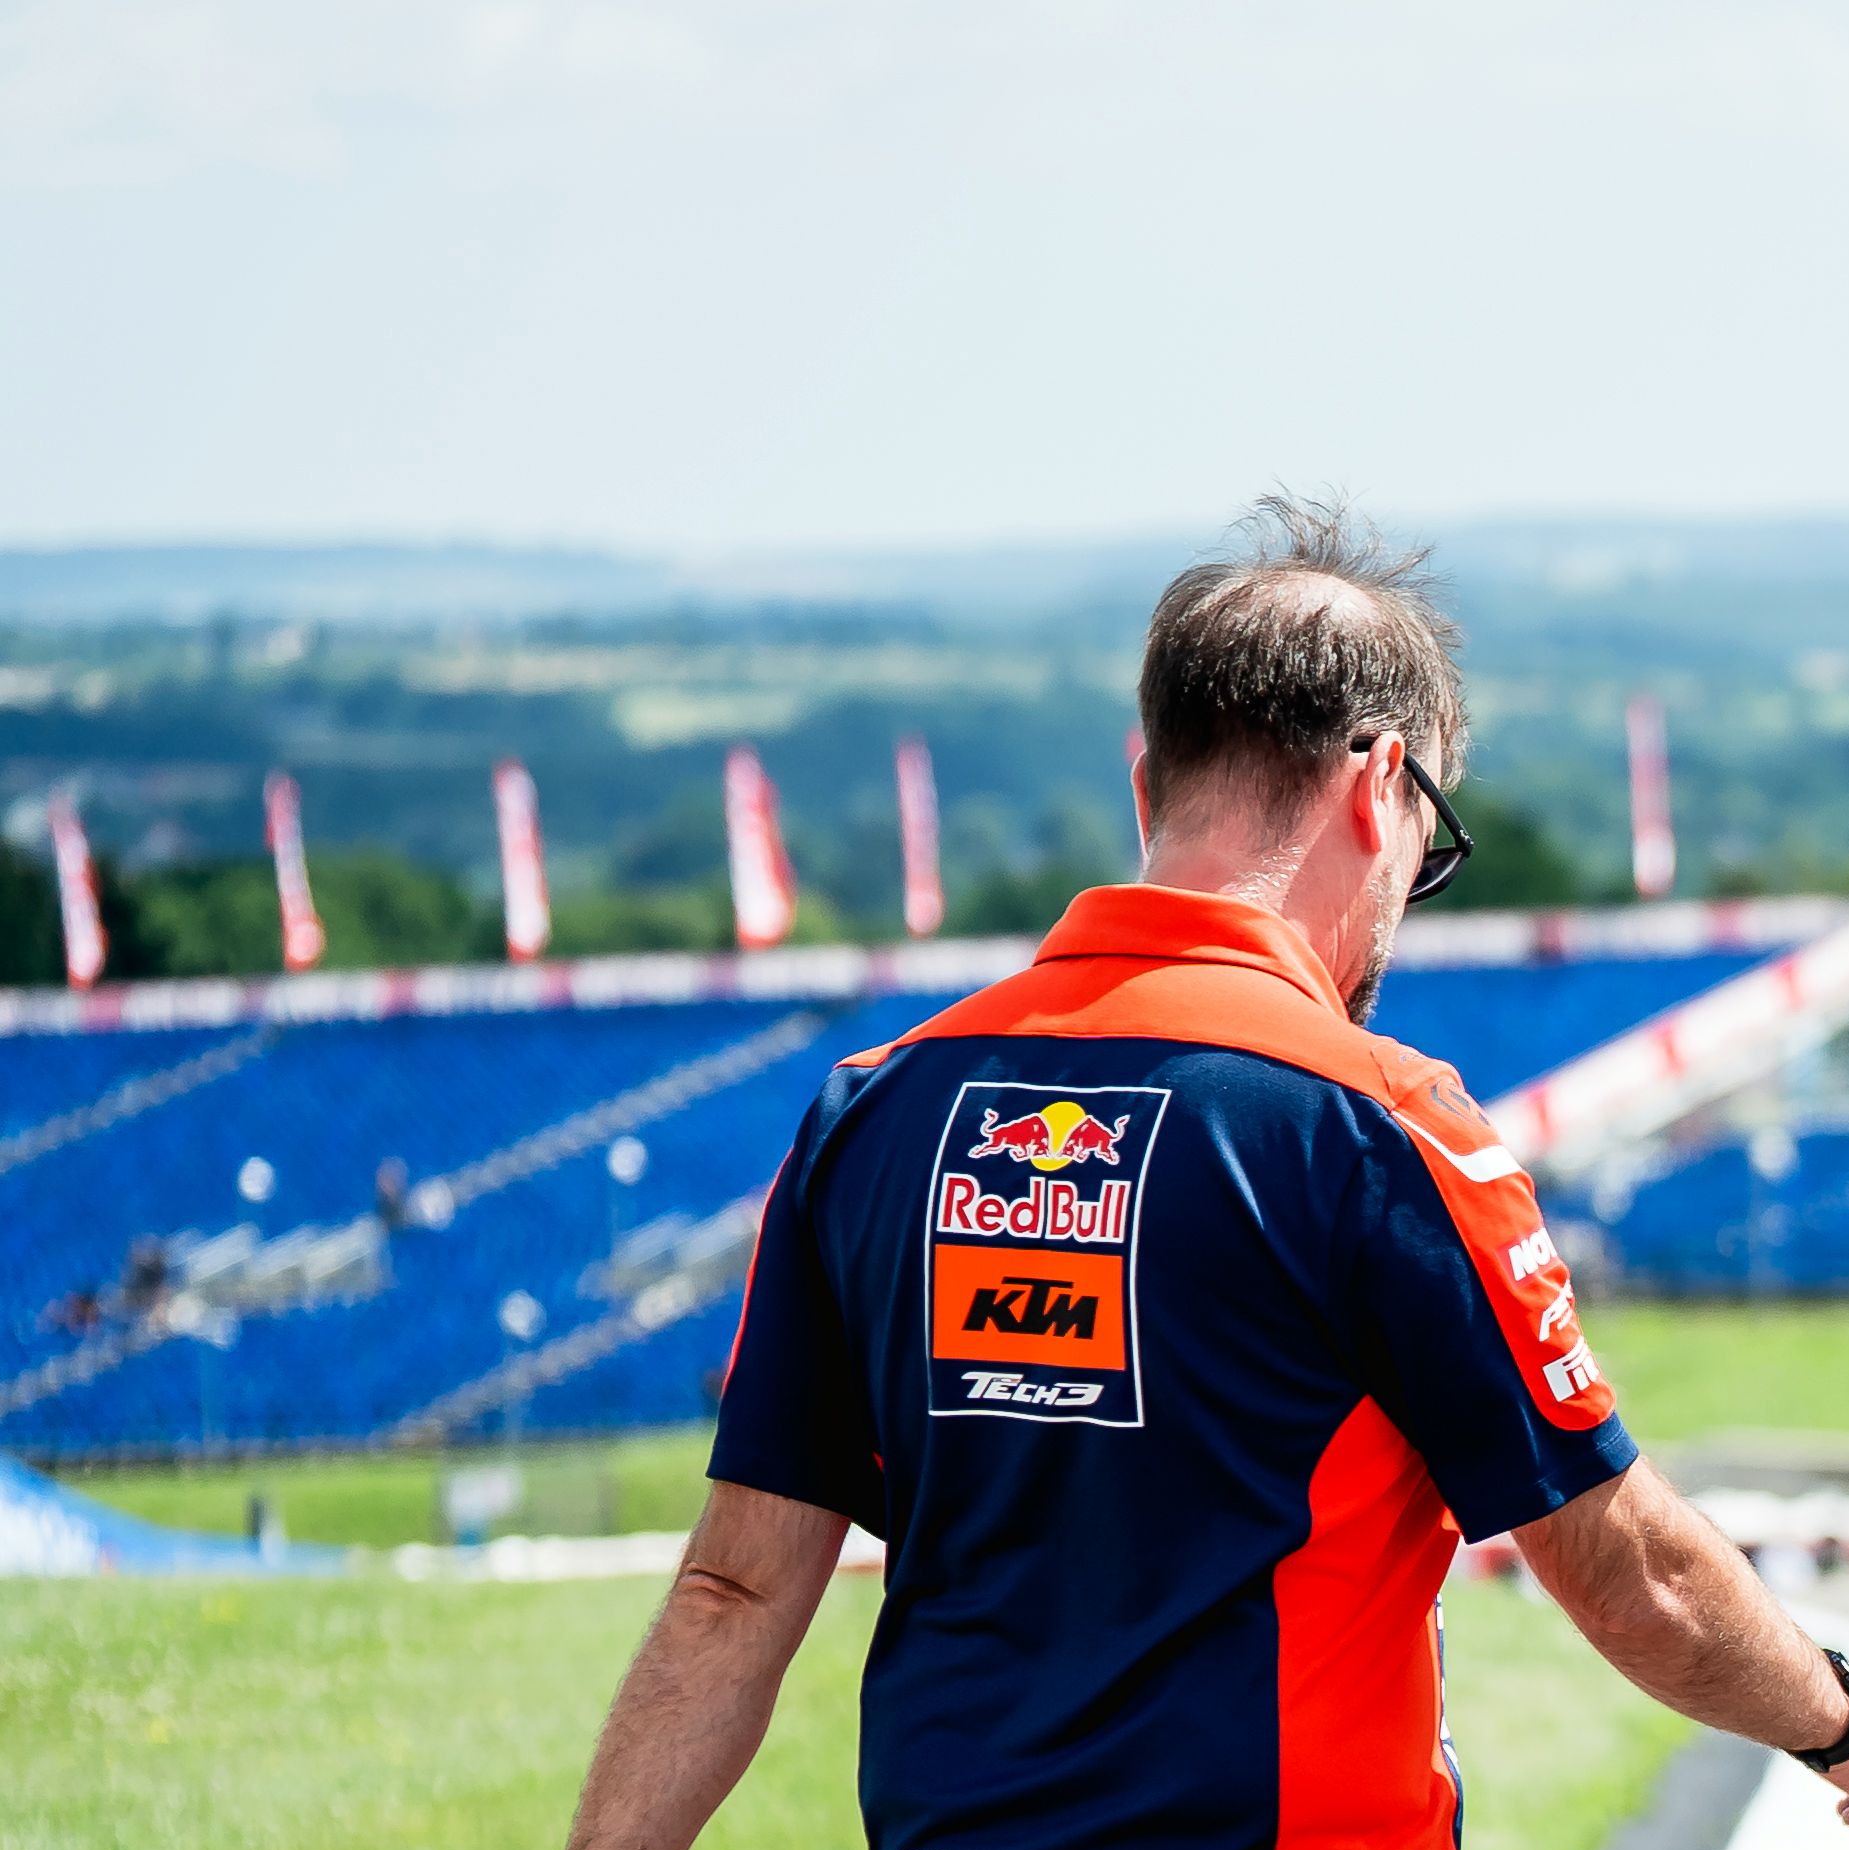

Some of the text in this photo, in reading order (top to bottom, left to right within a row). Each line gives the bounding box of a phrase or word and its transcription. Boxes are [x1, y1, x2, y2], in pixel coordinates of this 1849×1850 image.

[938, 1174, 1130, 1242] Red Bull
[961, 1276, 1099, 1340] KTM
